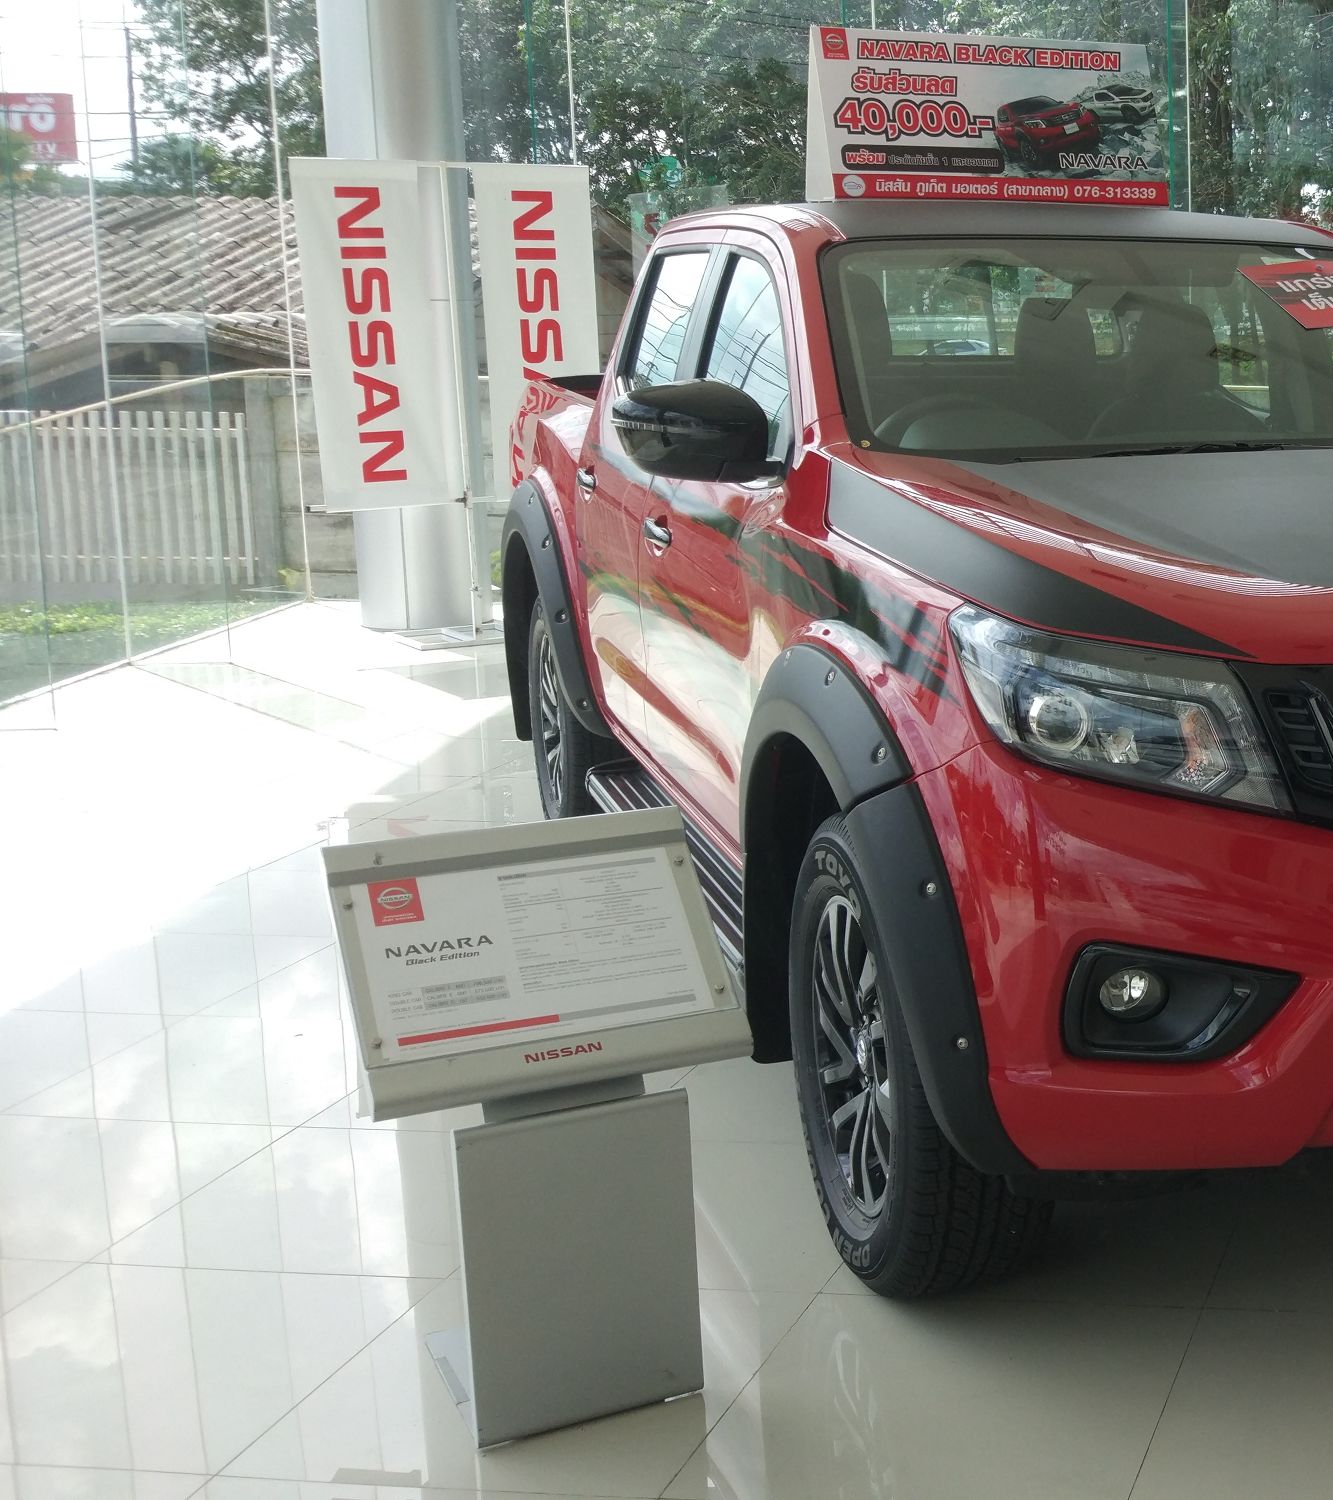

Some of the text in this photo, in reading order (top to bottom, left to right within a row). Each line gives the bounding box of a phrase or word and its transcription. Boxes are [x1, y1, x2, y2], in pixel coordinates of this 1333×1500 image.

[858, 39, 1120, 72] NAVARA BLACK EDITION
[852, 68, 957, 95] รับส่วนลด
[834, 99, 995, 140] 40,000.-
[845, 149, 886, 165] พร้อม
[1058, 152, 1149, 171] NAVARA
[875, 179, 1157, 199] นิสสัน ภูเก็ต มอเตอร์ (สาขาถลาง) 076-313339
[511, 190, 564, 381] NISS
[334, 186, 408, 483] NISSAN
[814, 850, 862, 920] TOYO
[384, 934, 494, 959] NAVARA
[405, 950, 480, 966] Black Edition
[523, 1041, 603, 1064] NISSAN
[832, 1226, 872, 1268] OPEN
